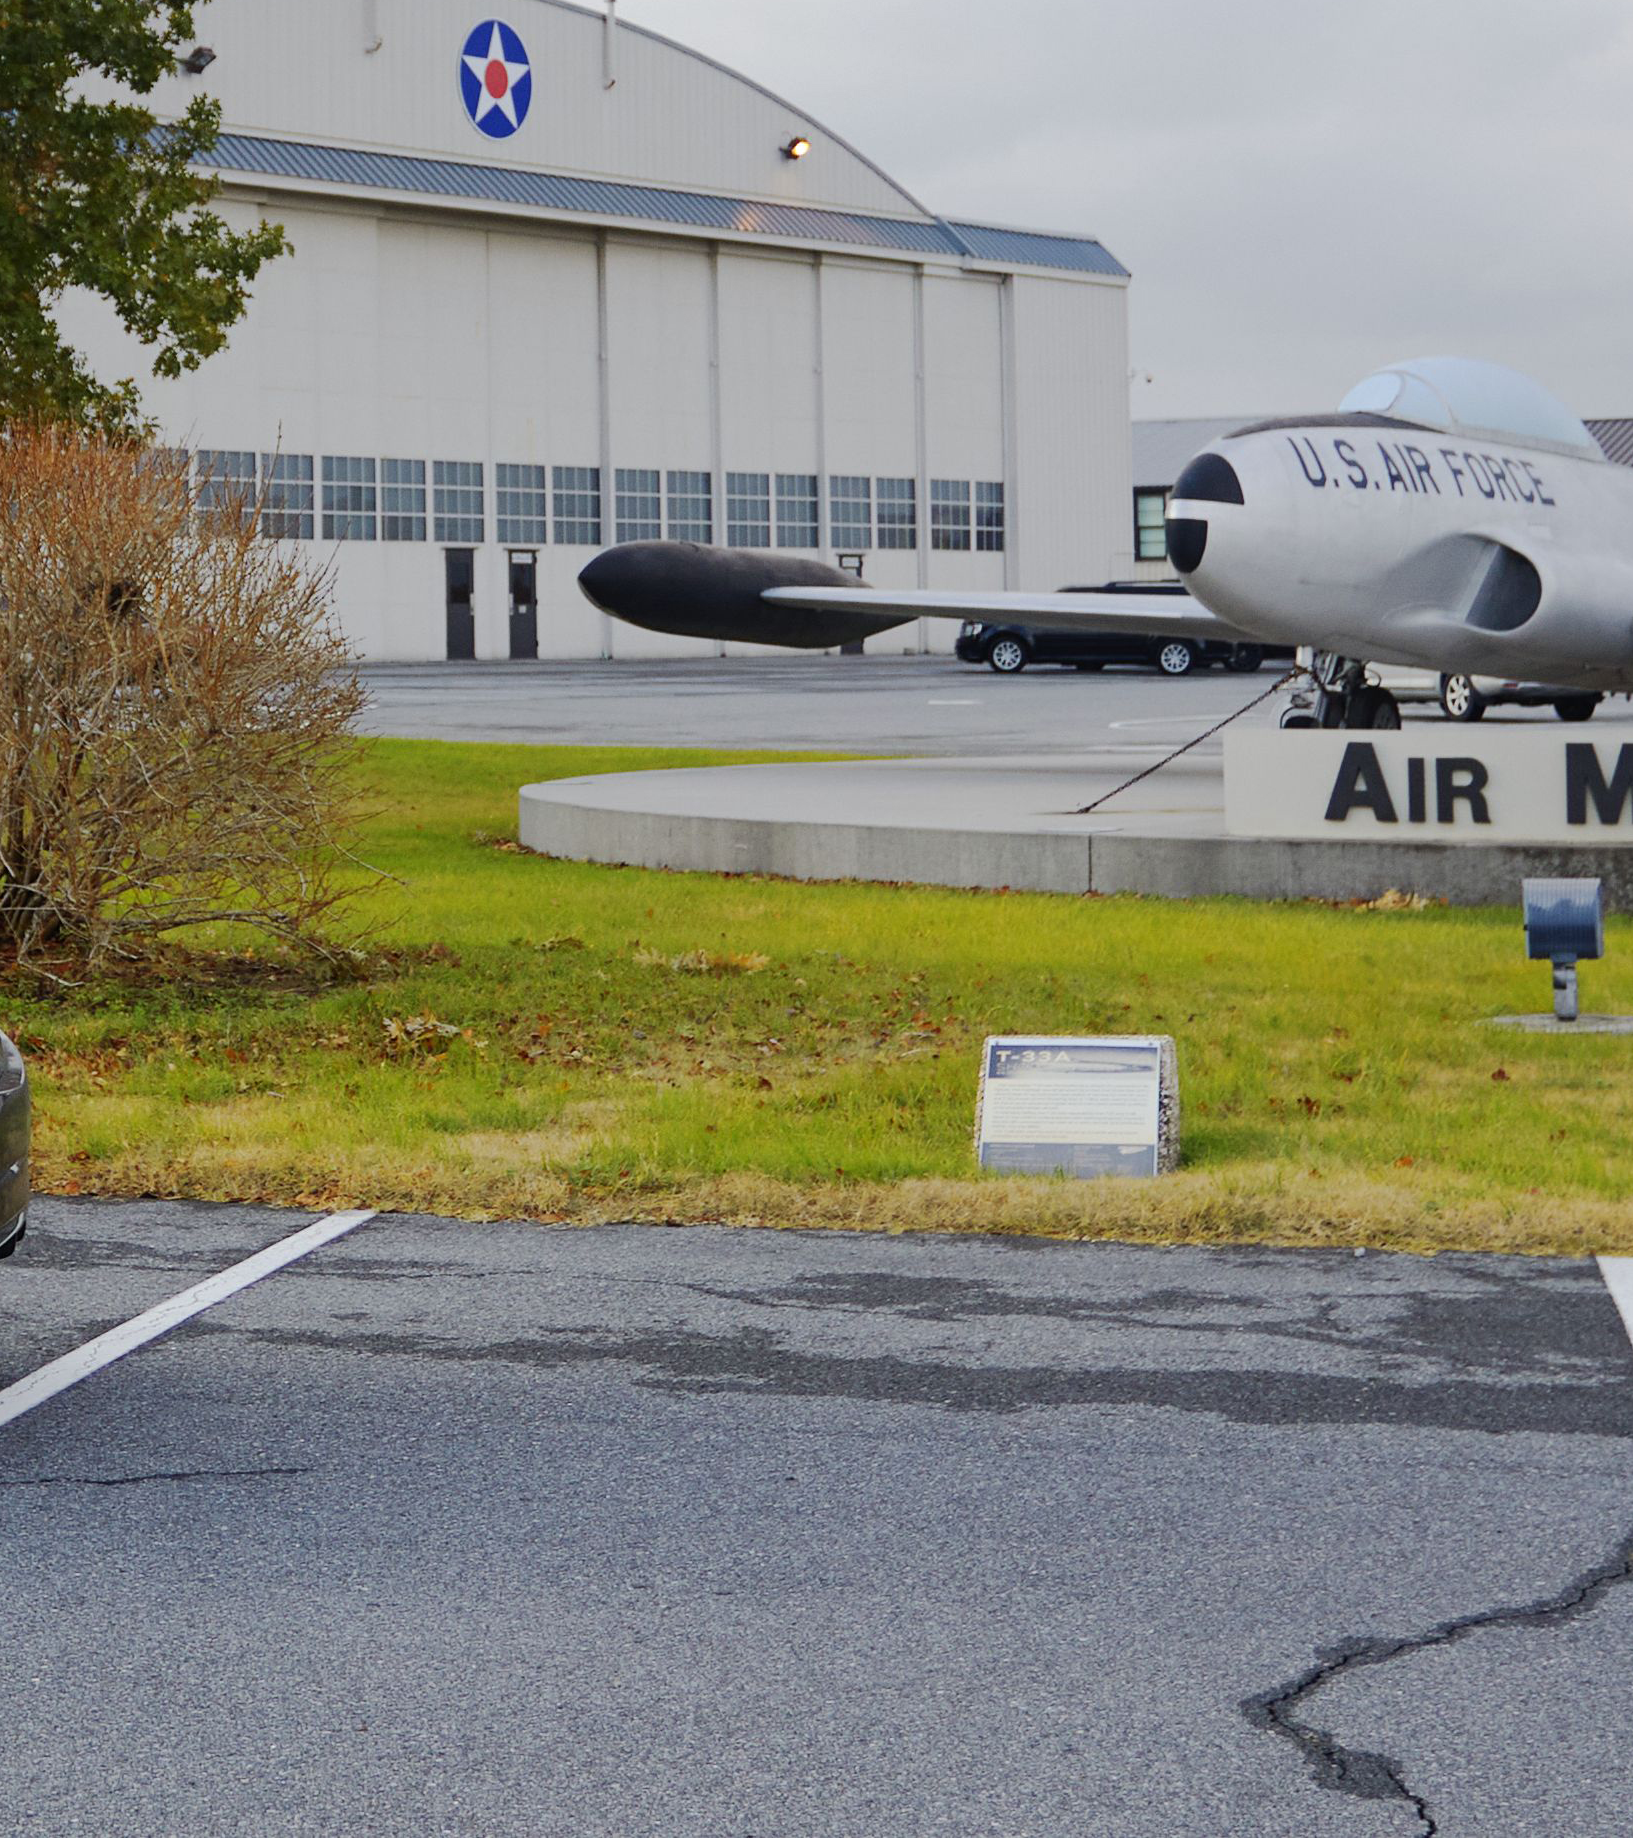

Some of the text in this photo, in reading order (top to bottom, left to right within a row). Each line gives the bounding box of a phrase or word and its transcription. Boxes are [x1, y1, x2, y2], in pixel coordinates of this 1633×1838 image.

[1287, 437, 1556, 507] U.S. AIR FORCE
[1325, 742, 1491, 825] AIR
[996, 1050, 1071, 1062] T-33A
